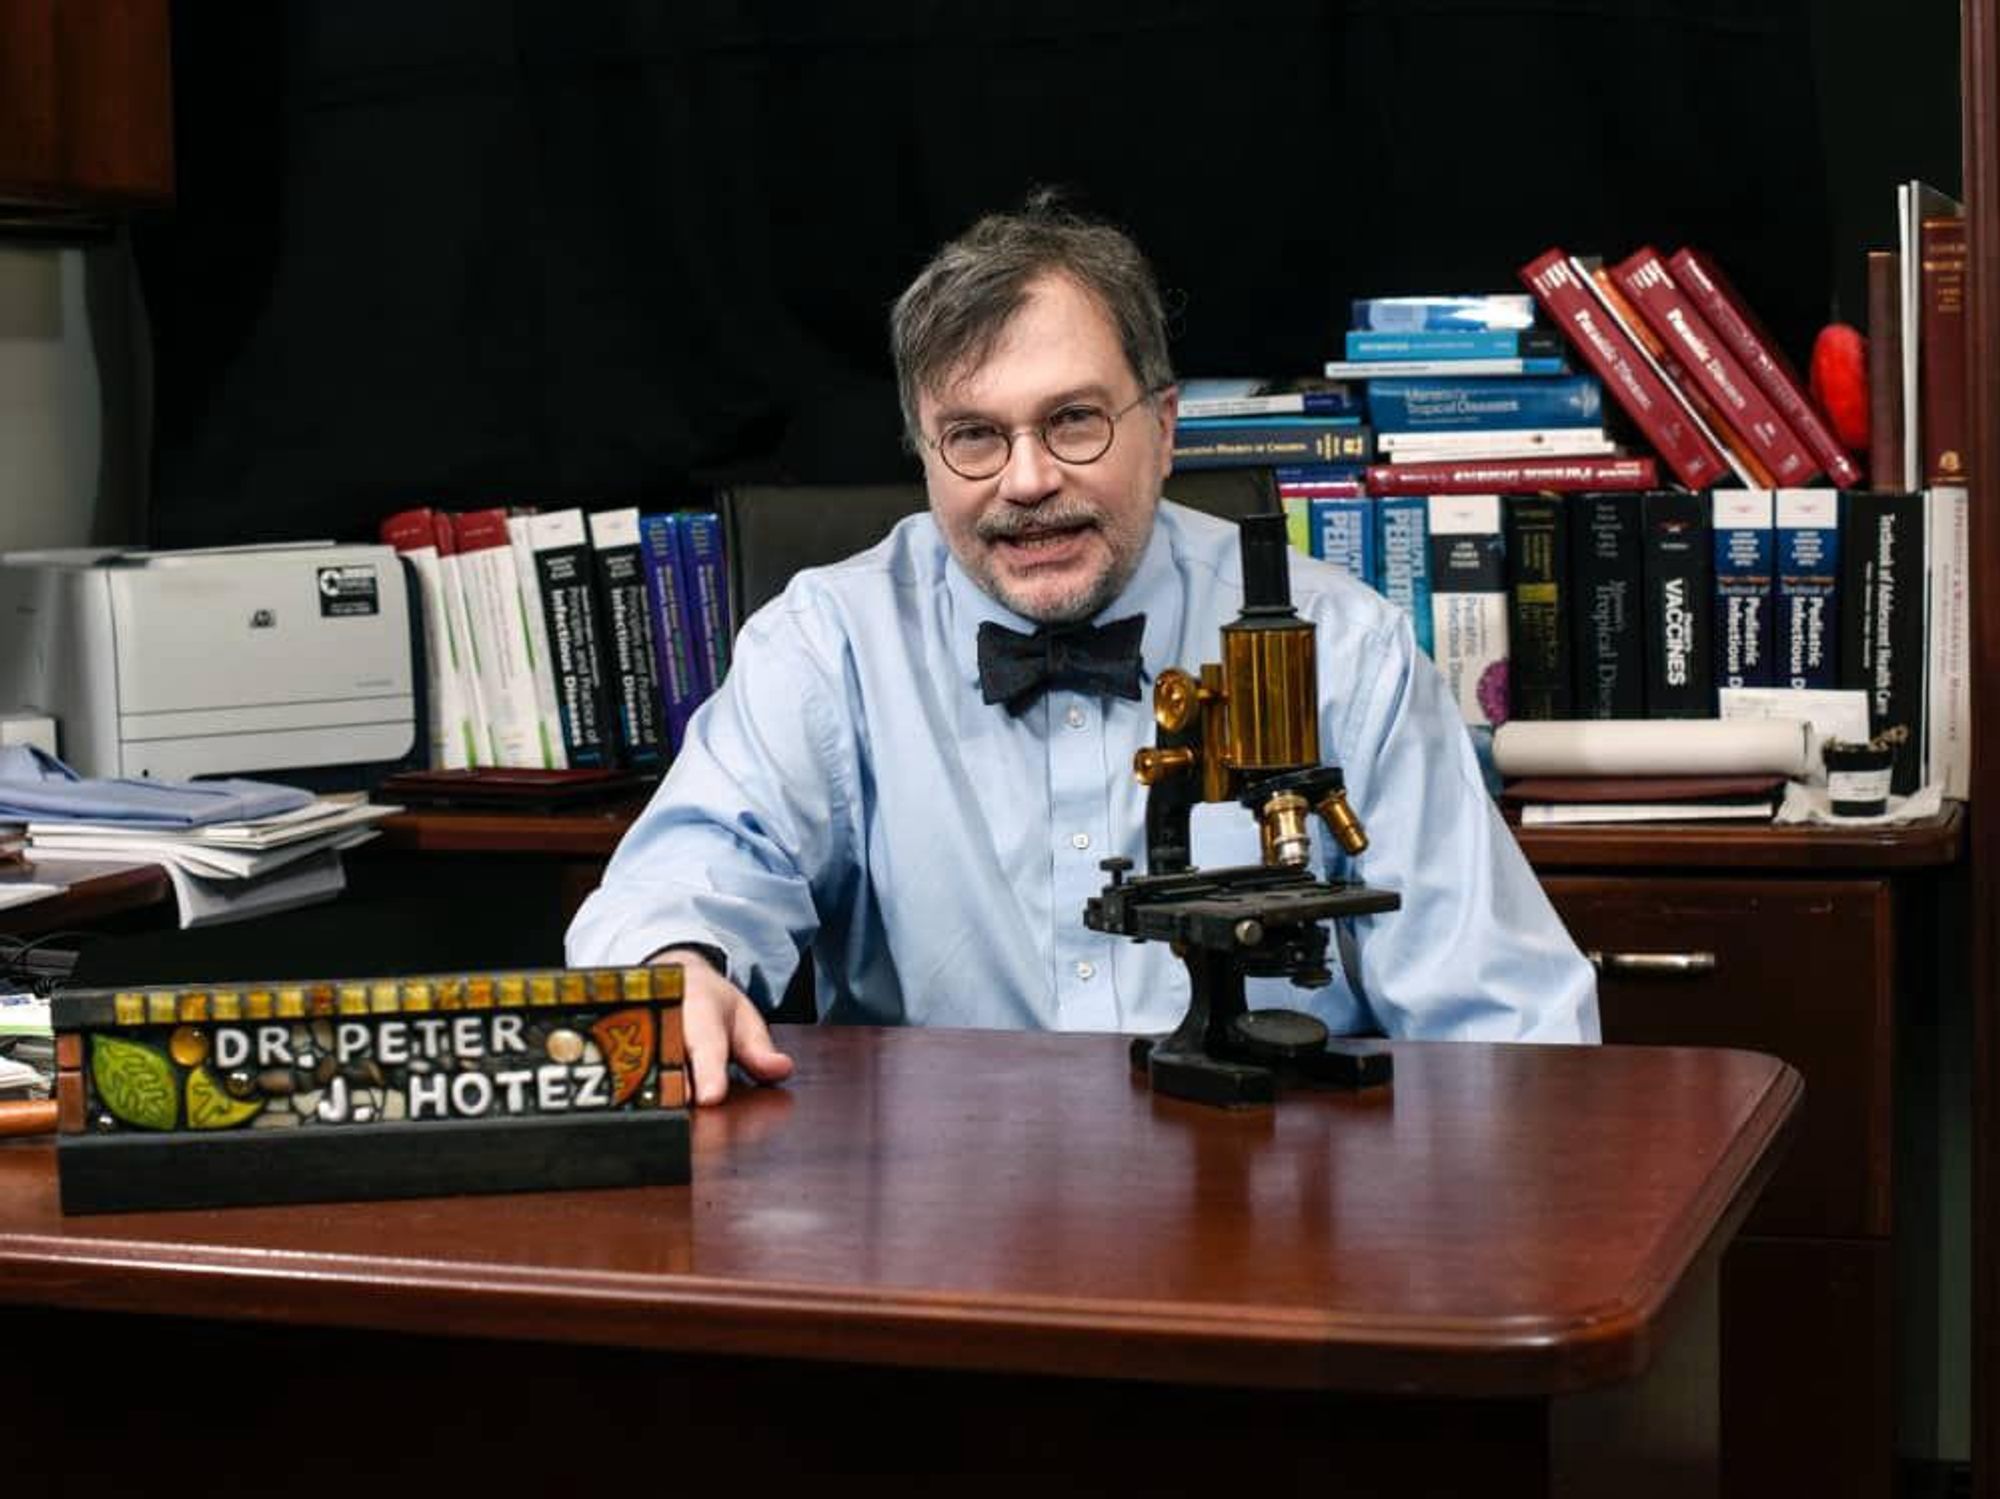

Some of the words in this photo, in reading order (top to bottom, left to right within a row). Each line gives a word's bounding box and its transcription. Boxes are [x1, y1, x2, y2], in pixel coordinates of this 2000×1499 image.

[1879, 513, 1895, 567] Textbook
[1592, 586, 1618, 657] Tropical
[1665, 578, 1686, 685] VACCINES
[1728, 597, 1743, 674] Infectious
[1746, 597, 1760, 666] Pediatric
[1791, 597, 1806, 674] Infectious
[1809, 597, 1823, 666] Pediatric
[1877, 583, 1895, 646] Adolescent
[552, 590, 572, 672] Infectious
[564, 676, 582, 746] Diseases
[611, 589, 631, 672] Infectious
[622, 676, 640, 745] Diseases
[1876, 649, 1892, 688] Health
[215, 1027, 315, 1068] DR.
[337, 1014, 527, 1065] PETER
[318, 1076, 373, 1122] J.
[409, 1065, 609, 1118] HOTEZ
